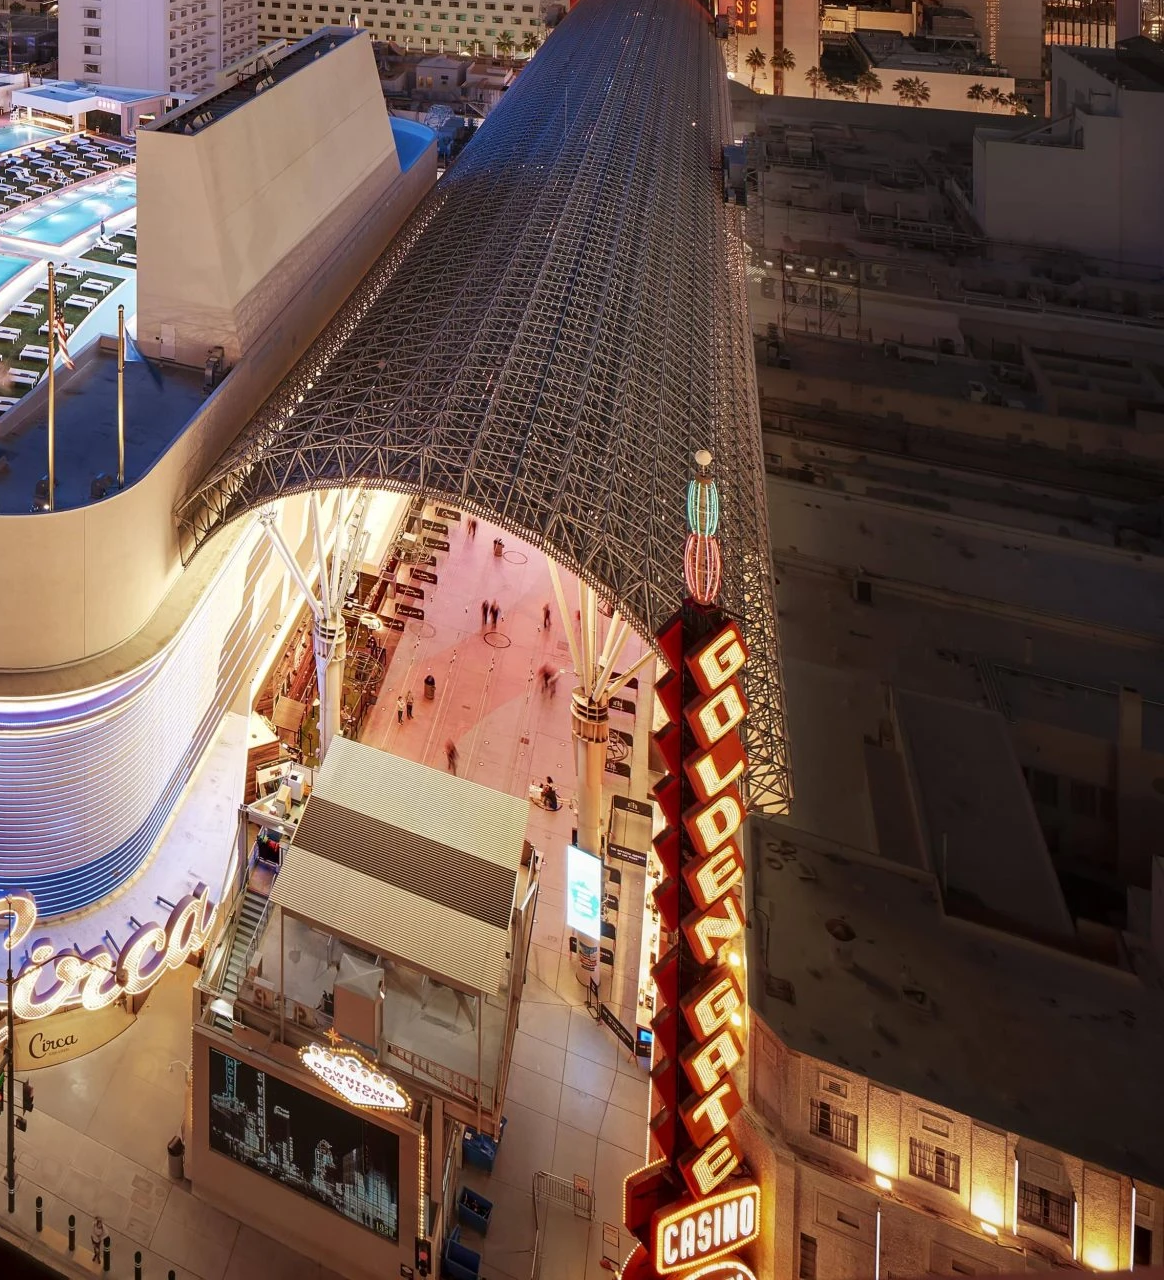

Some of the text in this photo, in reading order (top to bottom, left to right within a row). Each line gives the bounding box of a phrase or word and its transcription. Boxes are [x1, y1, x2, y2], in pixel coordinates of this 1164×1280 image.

[692, 629, 746, 1195] GOLDEN GATE
[28, 1032, 79, 1059] Circa
[313, 1061, 395, 1103] DOWNTOWN
[323, 1071, 342, 1085] LAS
[348, 1083, 384, 1104] VEGAS
[664, 1195, 755, 1265] CASINO
